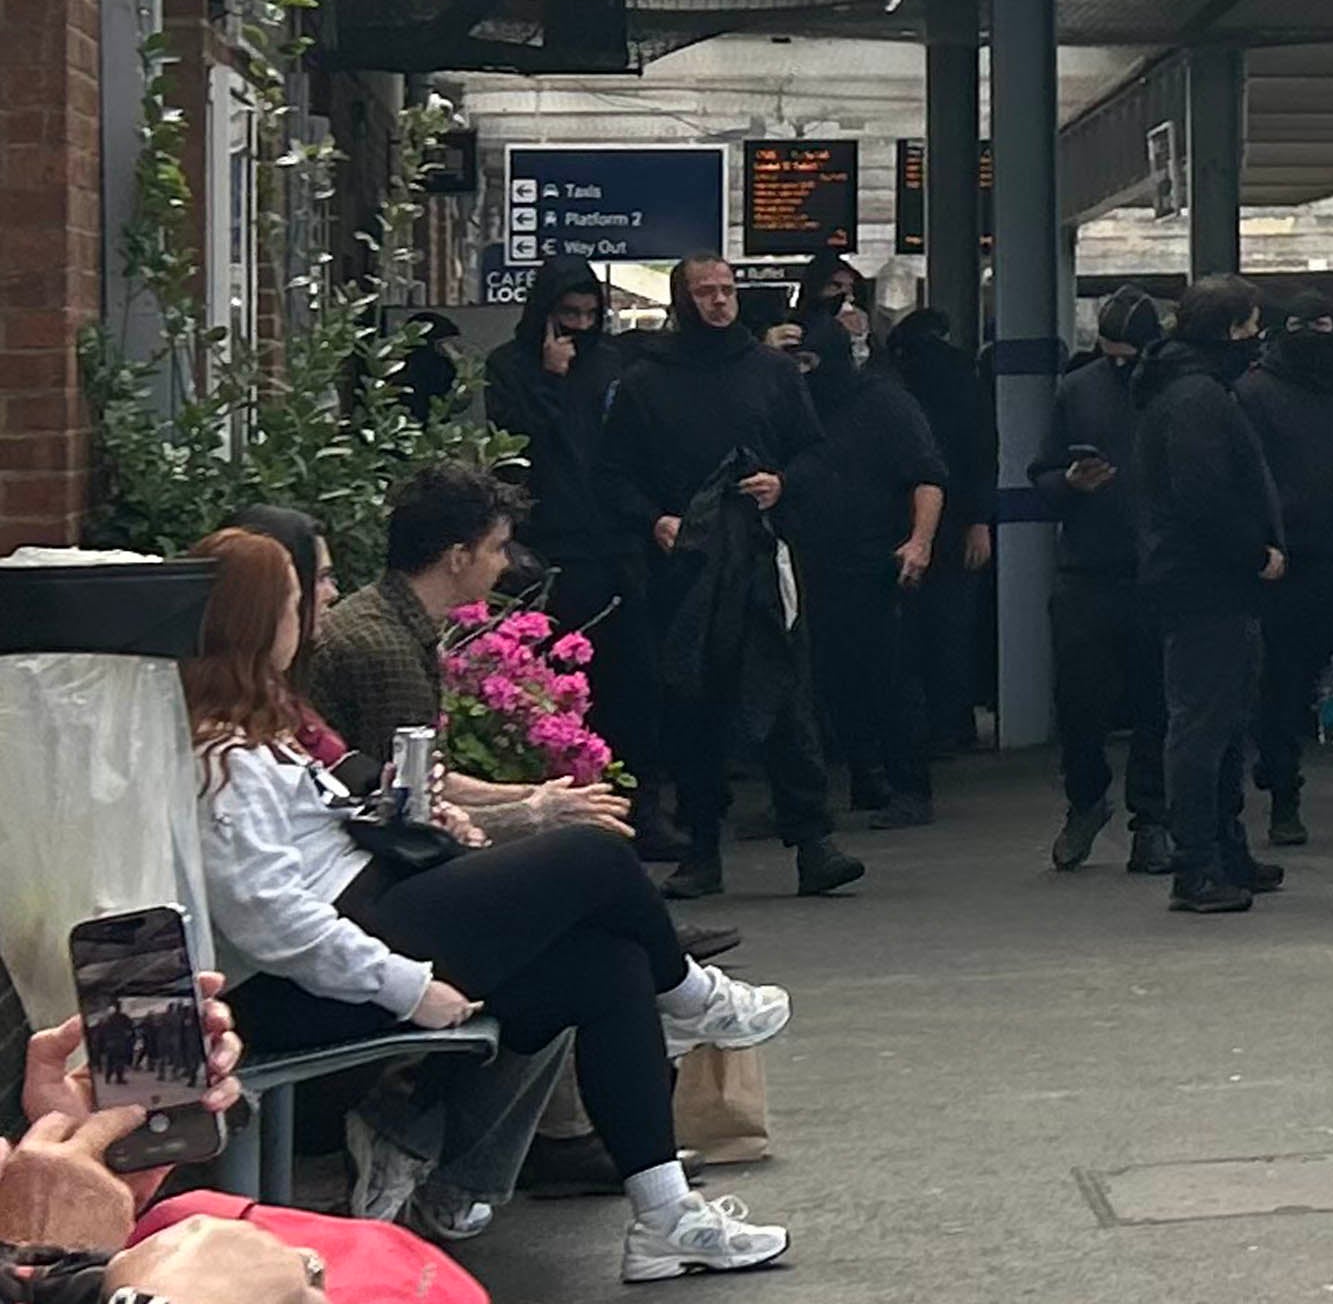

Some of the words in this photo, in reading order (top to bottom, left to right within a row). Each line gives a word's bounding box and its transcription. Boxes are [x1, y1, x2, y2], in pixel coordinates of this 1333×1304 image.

[564, 184, 602, 198] Taxis
[564, 211, 629, 227] Platform
[631, 212, 643, 226] 2
[564, 241, 595, 257] Way
[598, 240, 627, 255] Out
